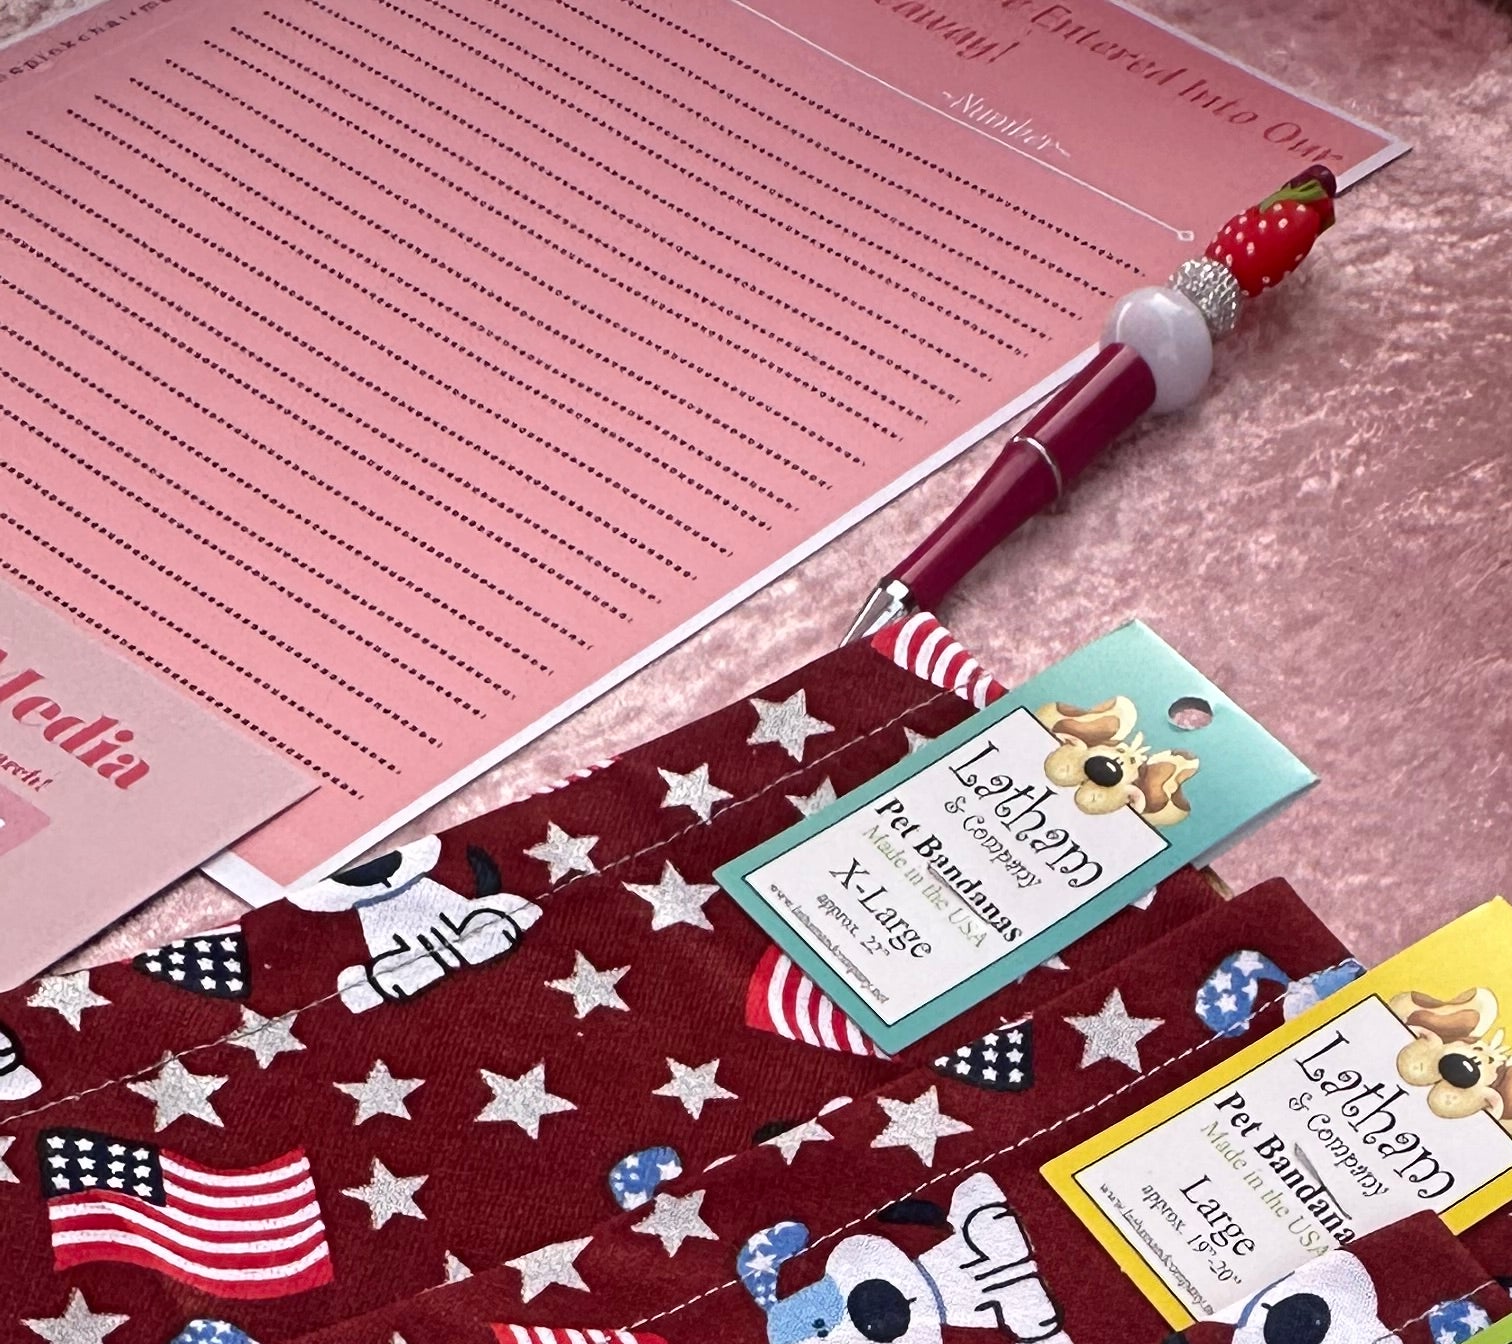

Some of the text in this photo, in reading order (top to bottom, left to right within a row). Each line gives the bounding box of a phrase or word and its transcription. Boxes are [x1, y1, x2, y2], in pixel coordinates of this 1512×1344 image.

[1030, 4, 1343, 162] Entered Into Our
[875, 798, 1022, 943] Pet Bandanas
[944, 796, 1042, 889] & Company
[947, 739, 1104, 889] Latham
[829, 858, 932, 958] X-Large
[863, 825, 988, 948] Made in the USA
[1214, 1090, 1263, 1137] Pet
[1289, 1092, 1390, 1199] & Company
[1294, 1030, 1455, 1201] Latham
[1179, 1174, 1256, 1256] Large
[1200, 1121, 1329, 1256] Made in the USA
